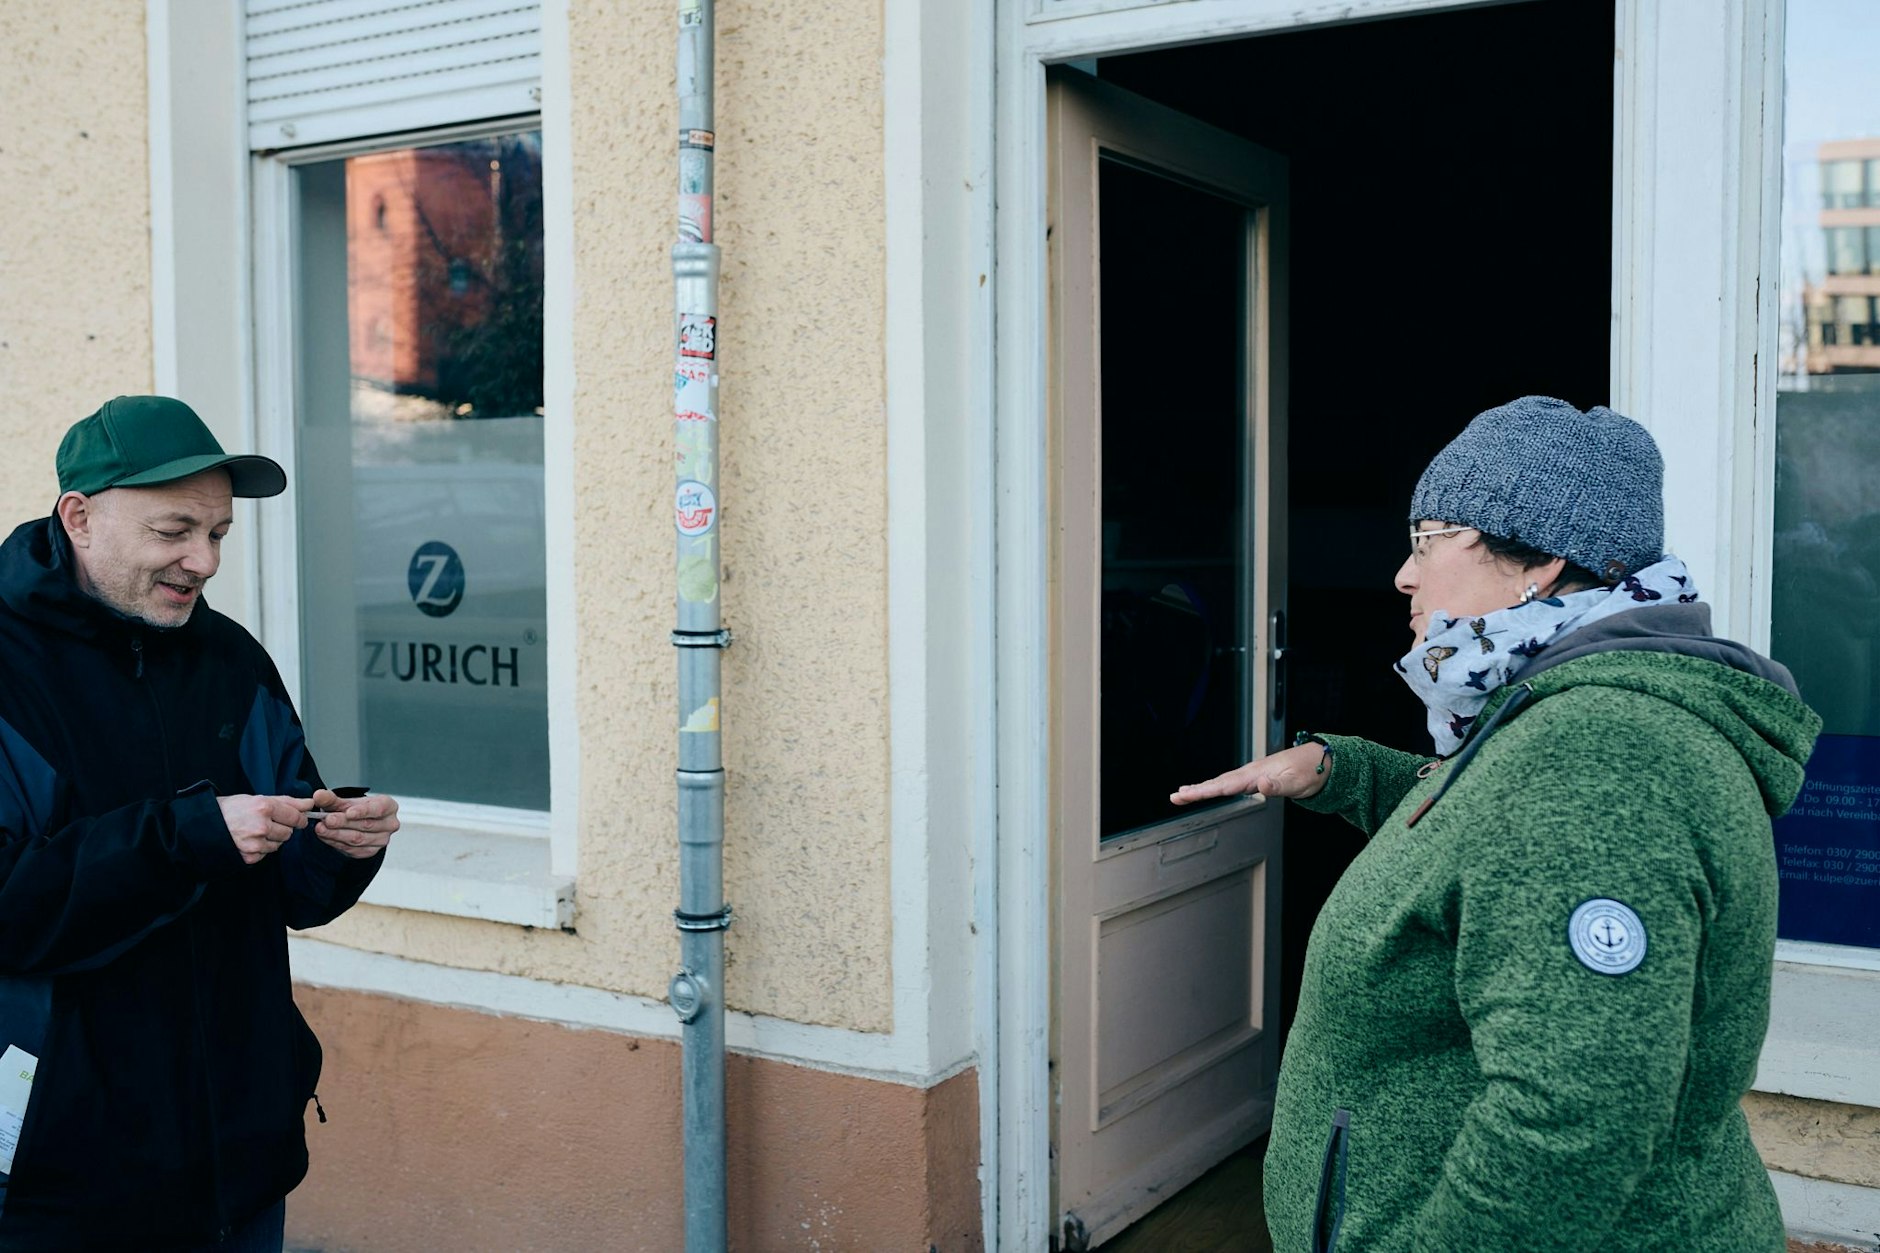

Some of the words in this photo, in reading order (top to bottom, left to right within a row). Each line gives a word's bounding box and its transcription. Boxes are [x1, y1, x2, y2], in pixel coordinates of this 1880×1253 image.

[363, 640, 520, 687] ZURICH
[1790, 806, 1805, 816] nd
[1807, 807, 1833, 818] nach
[1823, 859, 1844, 871] 030
